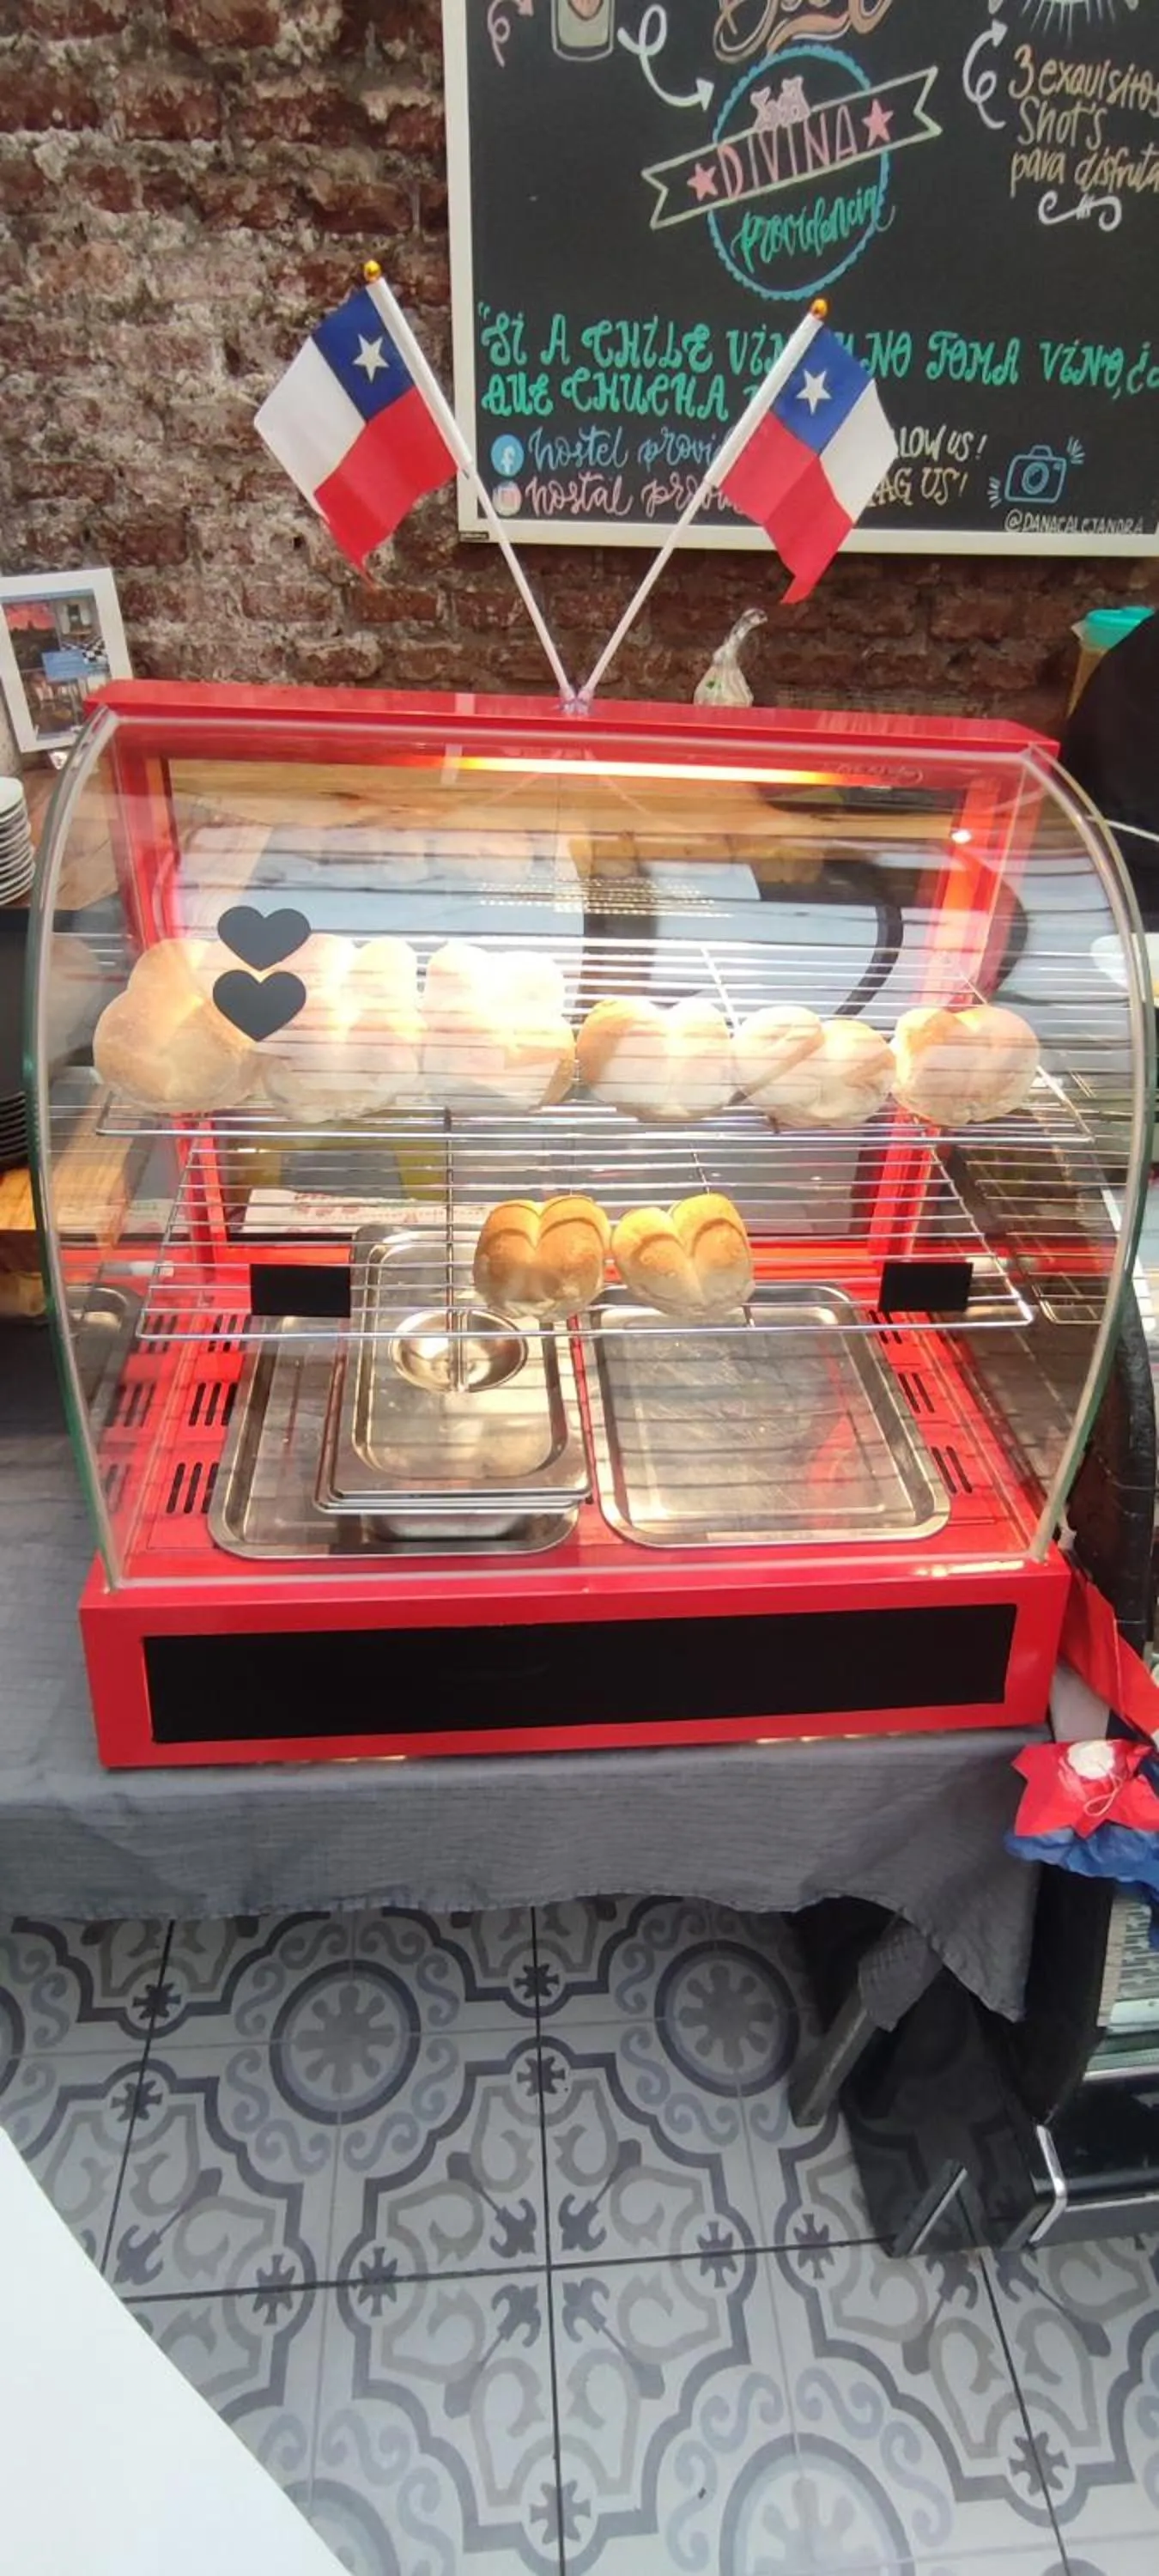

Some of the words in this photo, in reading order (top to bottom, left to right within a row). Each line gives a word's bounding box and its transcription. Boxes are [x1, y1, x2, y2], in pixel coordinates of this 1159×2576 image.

[1008, 44, 1035, 100] 3
[1016, 96, 1108, 151] Shot's
[717, 105, 858, 200] DIVINA
[1010, 147, 1067, 199] para
[540, 313, 571, 366] A
[860, 330, 912, 378] NO
[561, 367, 730, 422] CHUCHA
[529, 424, 629, 471] hostel
[525, 472, 634, 516] hostal
